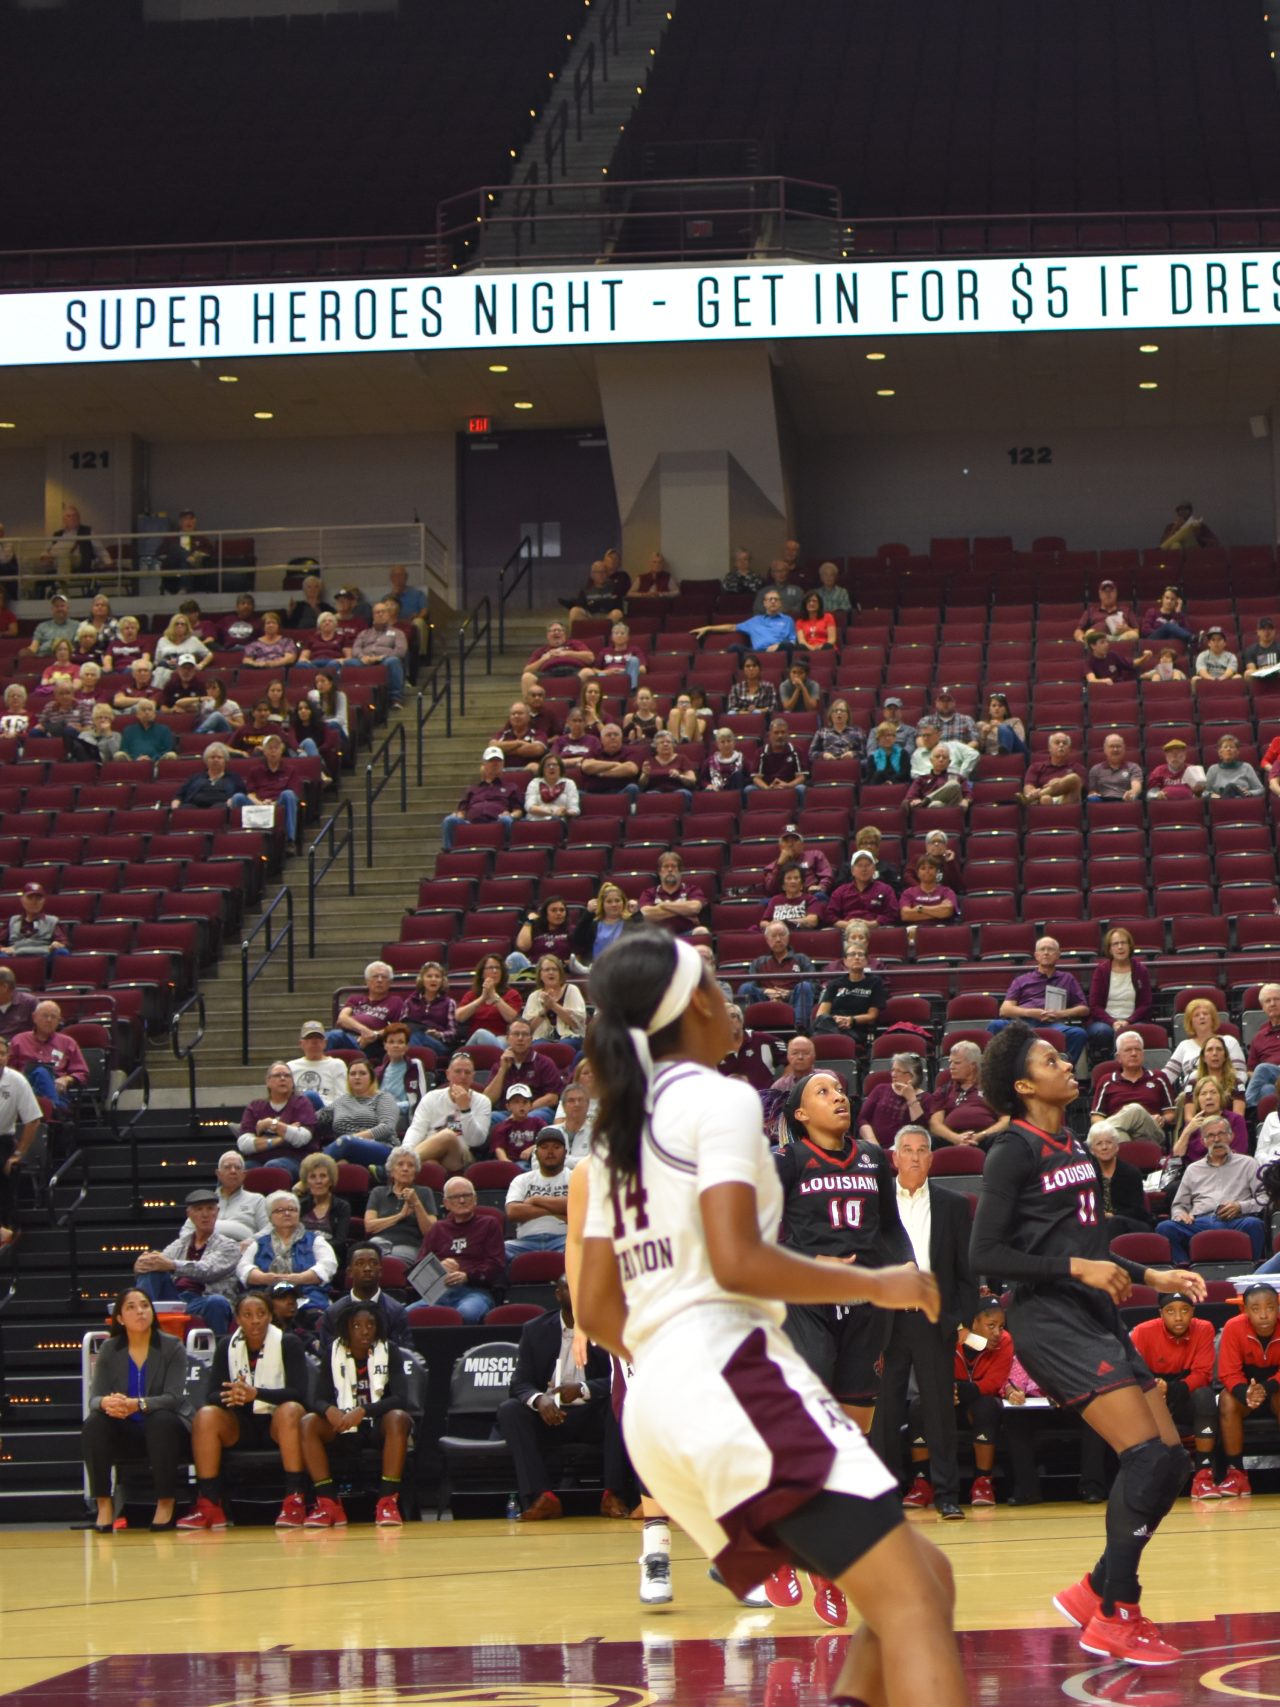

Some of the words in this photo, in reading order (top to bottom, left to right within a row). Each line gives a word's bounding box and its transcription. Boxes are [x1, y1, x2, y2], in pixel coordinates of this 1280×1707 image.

[66, 295, 221, 353] SUPER
[253, 285, 443, 344] HEROES
[475, 279, 624, 337] NIGHT
[697, 274, 785, 328] GET
[815, 272, 859, 325] IN
[891, 269, 980, 323] FOR
[1011, 262, 1068, 324] $5
[1100, 265, 1138, 317] IF
[69, 451, 110, 469] 121
[1007, 446, 1053, 465] 122
[1042, 1162, 1097, 1194] LOUISIA
[828, 1197, 866, 1230] 10
[464, 1356, 518, 1373] MUSCL
[473, 1371, 513, 1387] MILK
